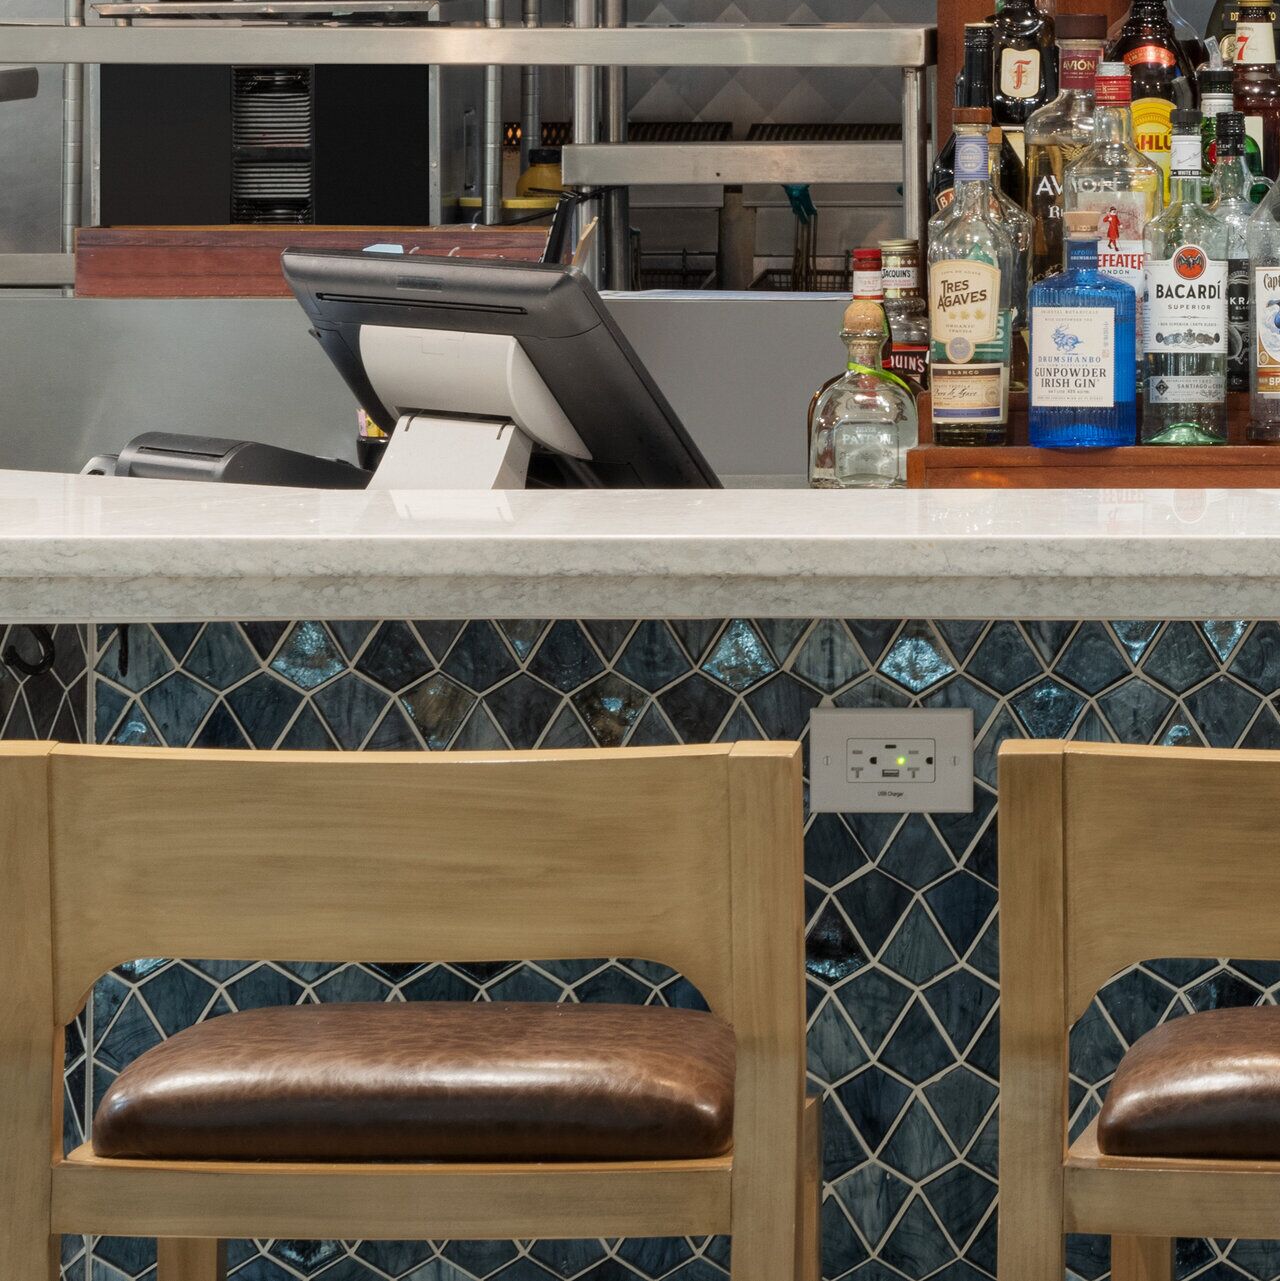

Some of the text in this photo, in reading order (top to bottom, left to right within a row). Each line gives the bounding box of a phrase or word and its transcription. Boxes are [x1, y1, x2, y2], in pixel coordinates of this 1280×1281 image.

[1236, 36, 1250, 60] 7
[1097, 253, 1144, 270] EFEATER
[881, 268, 912, 279] JACQUIN'S
[940, 279, 970, 298] TRES
[1156, 281, 1222, 299] BACARDÍ
[937, 289, 988, 312] AGAVES
[1038, 356, 1102, 364] DRUMSHANBO
[1034, 368, 1108, 378] GUNPOWDER
[1041, 378, 1096, 388] IRISH GIN
